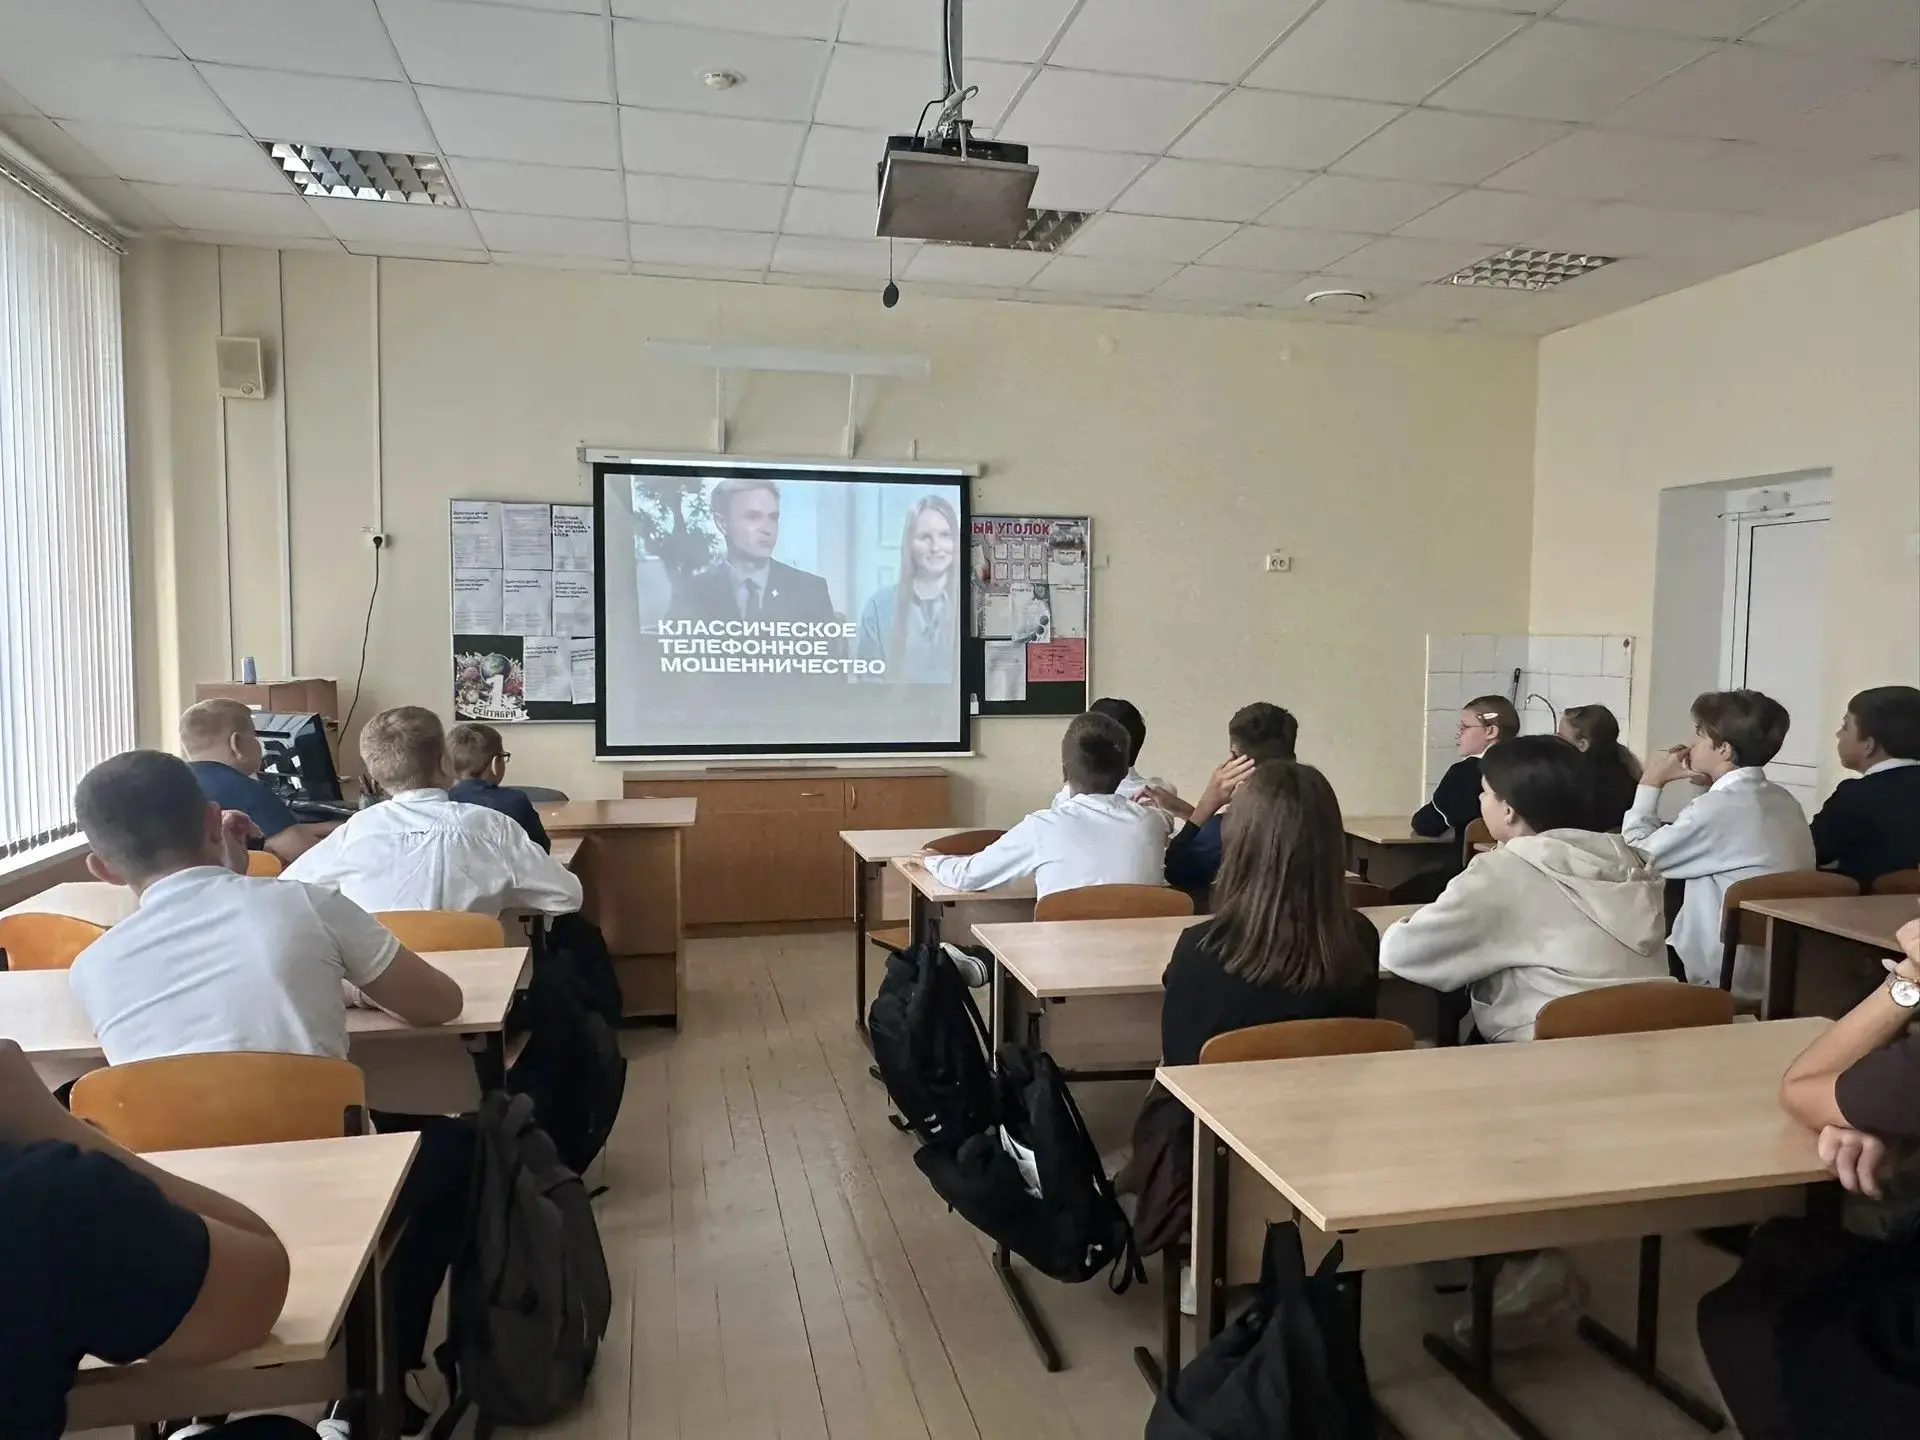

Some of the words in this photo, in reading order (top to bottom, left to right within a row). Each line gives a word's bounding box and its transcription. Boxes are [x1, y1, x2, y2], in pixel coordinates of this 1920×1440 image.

[971, 521, 993, 534] ЫЙ
[998, 522, 1050, 535] УГОЛОК
[658, 619, 857, 638] КЛАССИЧЕСКОЕ
[658, 638, 828, 655] ТЕЛЕФОННОЕ
[660, 657, 885, 674] МОШЕННИЧЕСТВО
